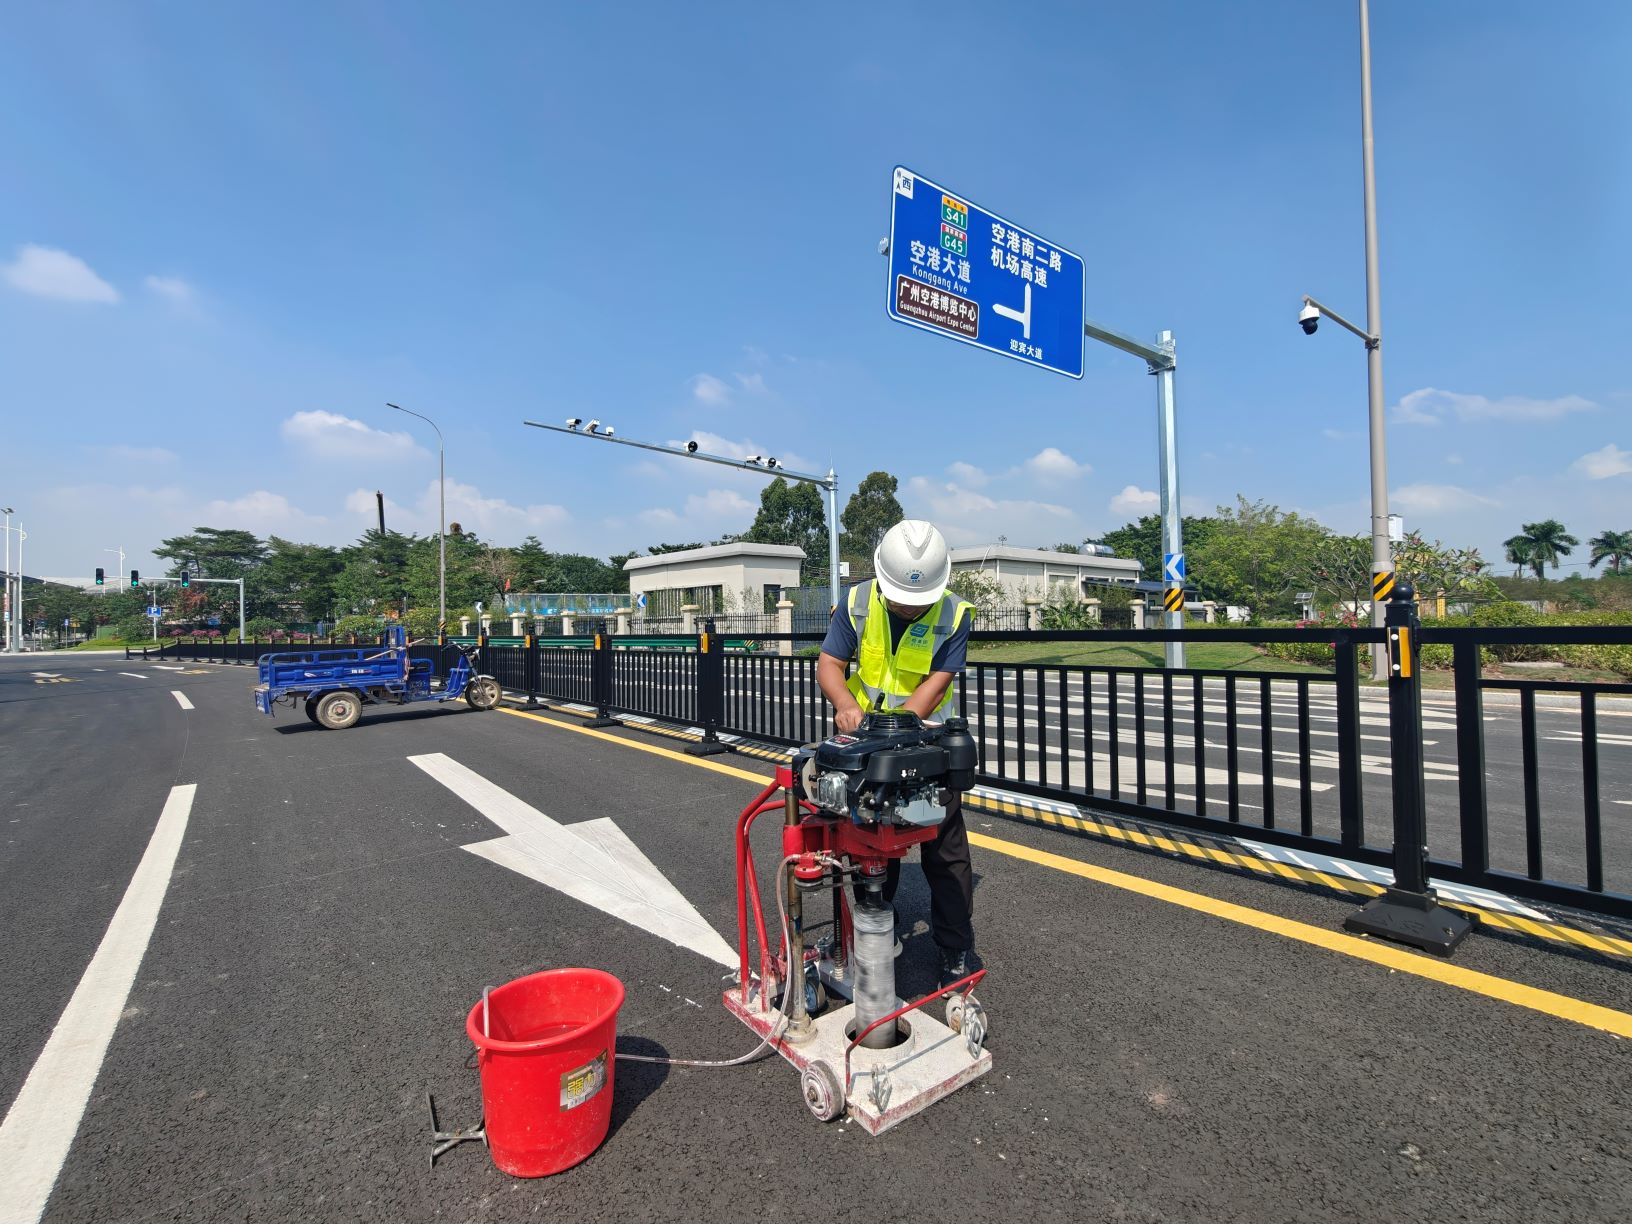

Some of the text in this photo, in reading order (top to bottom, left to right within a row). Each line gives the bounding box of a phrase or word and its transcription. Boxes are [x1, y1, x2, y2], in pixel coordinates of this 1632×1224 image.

[902, 176, 912, 191] 西
[946, 207, 964, 226] S41
[944, 235, 963, 253] G45
[991, 223, 1062, 272] 空港南二路
[909, 240, 971, 283] 空港大道
[990, 245, 1048, 288] 机场高速
[912, 265, 968, 295] Konggang Ave
[899, 280, 977, 322] 广州空港博览中心
[900, 300, 976, 334] Guangzhou Airport Expo Center
[1009, 338, 1043, 360] 迎宾大道
